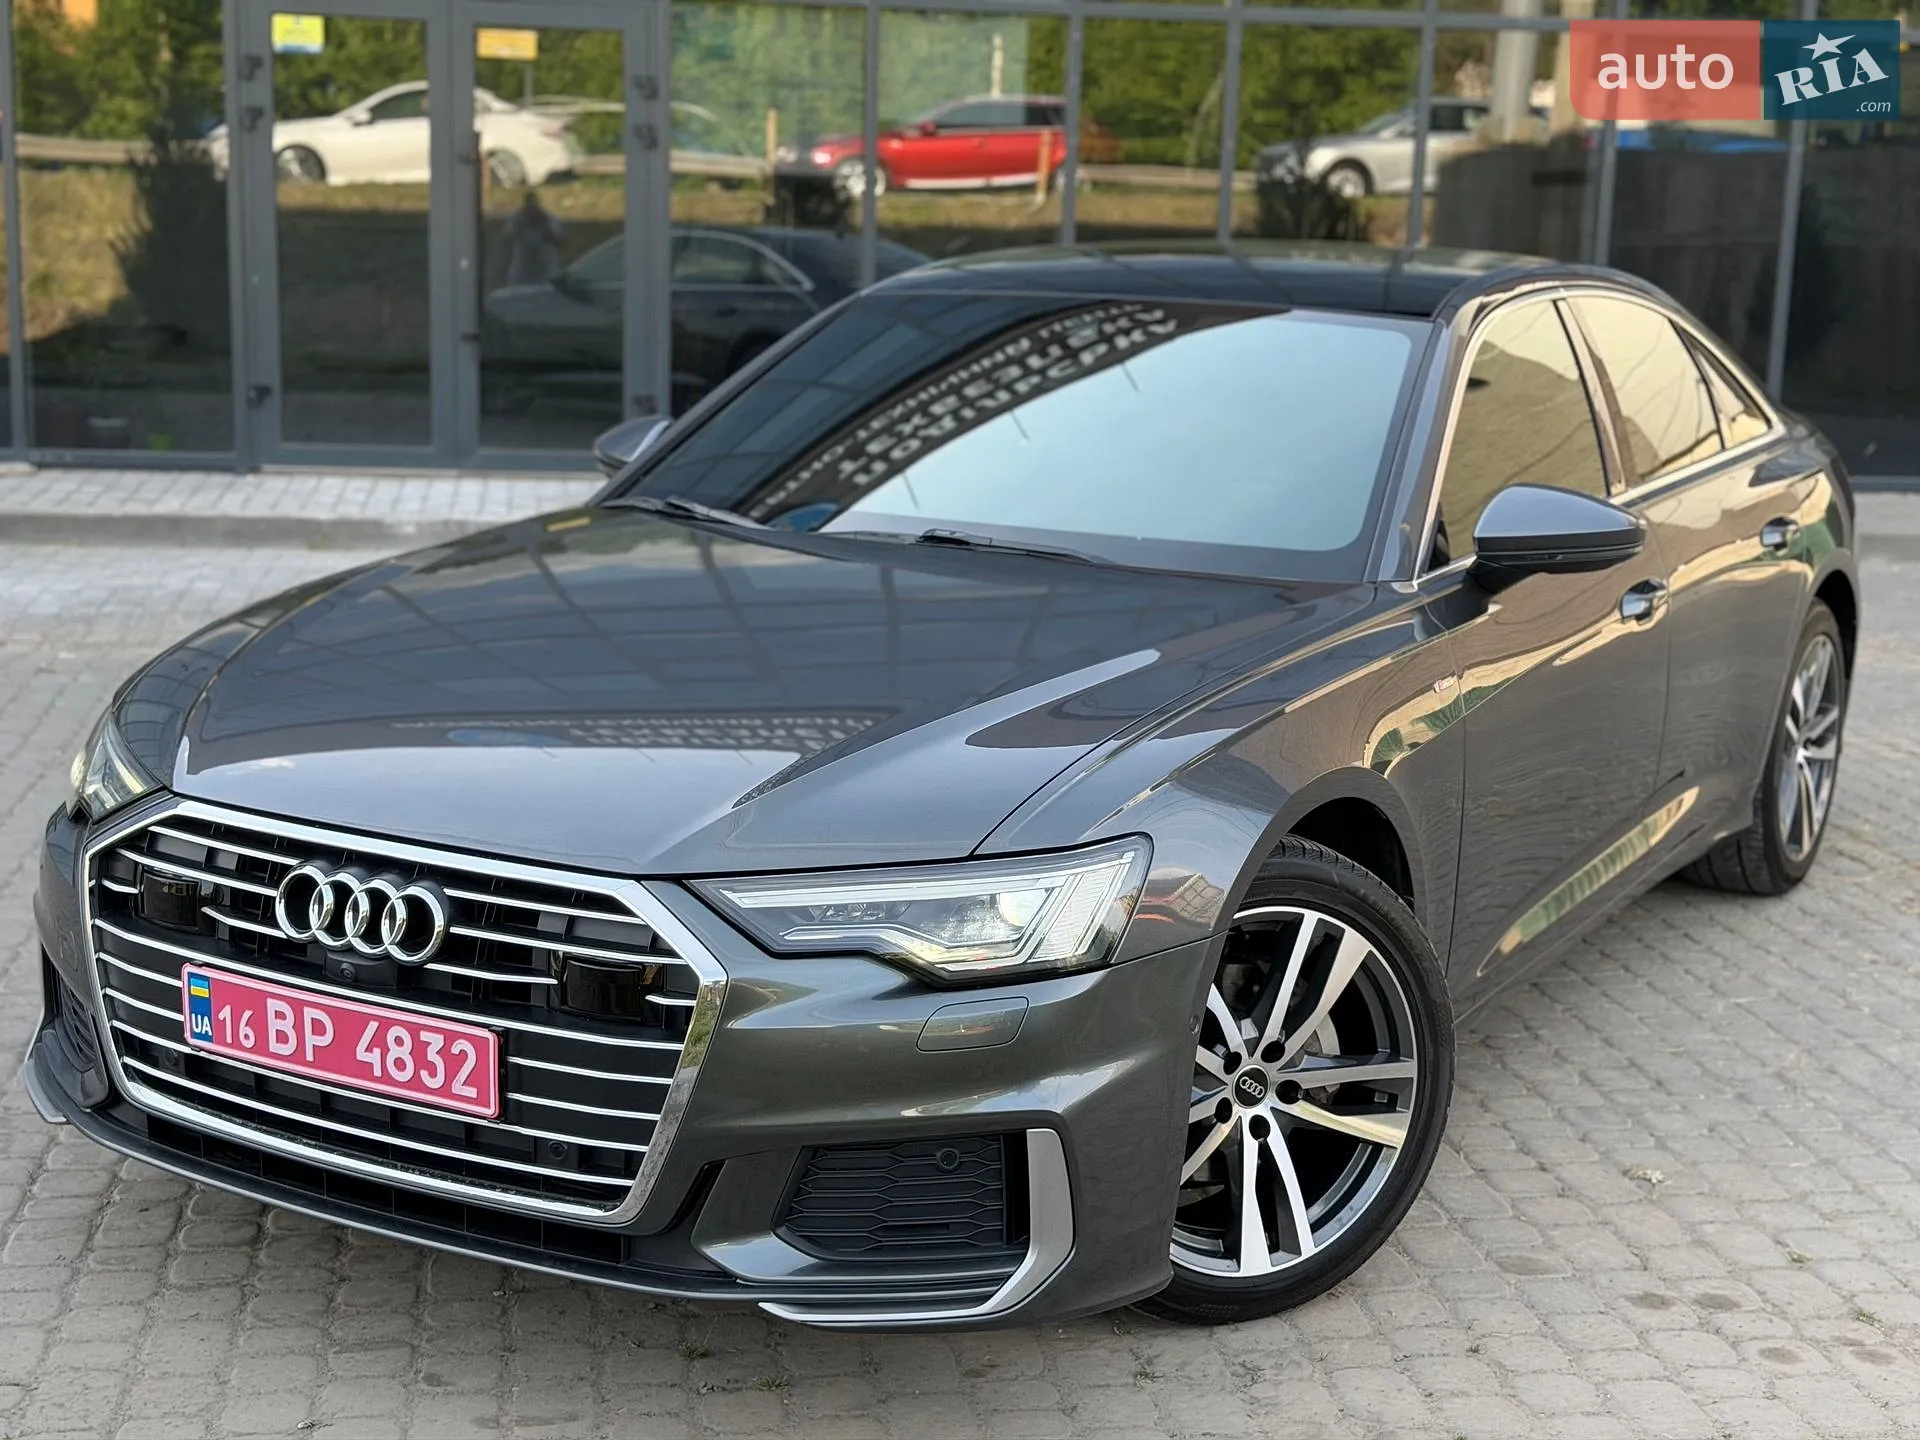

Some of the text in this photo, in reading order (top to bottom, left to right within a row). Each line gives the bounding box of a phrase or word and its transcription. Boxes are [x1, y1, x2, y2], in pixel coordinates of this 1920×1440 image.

[192, 997, 479, 1099] UA 16 BP 4832
